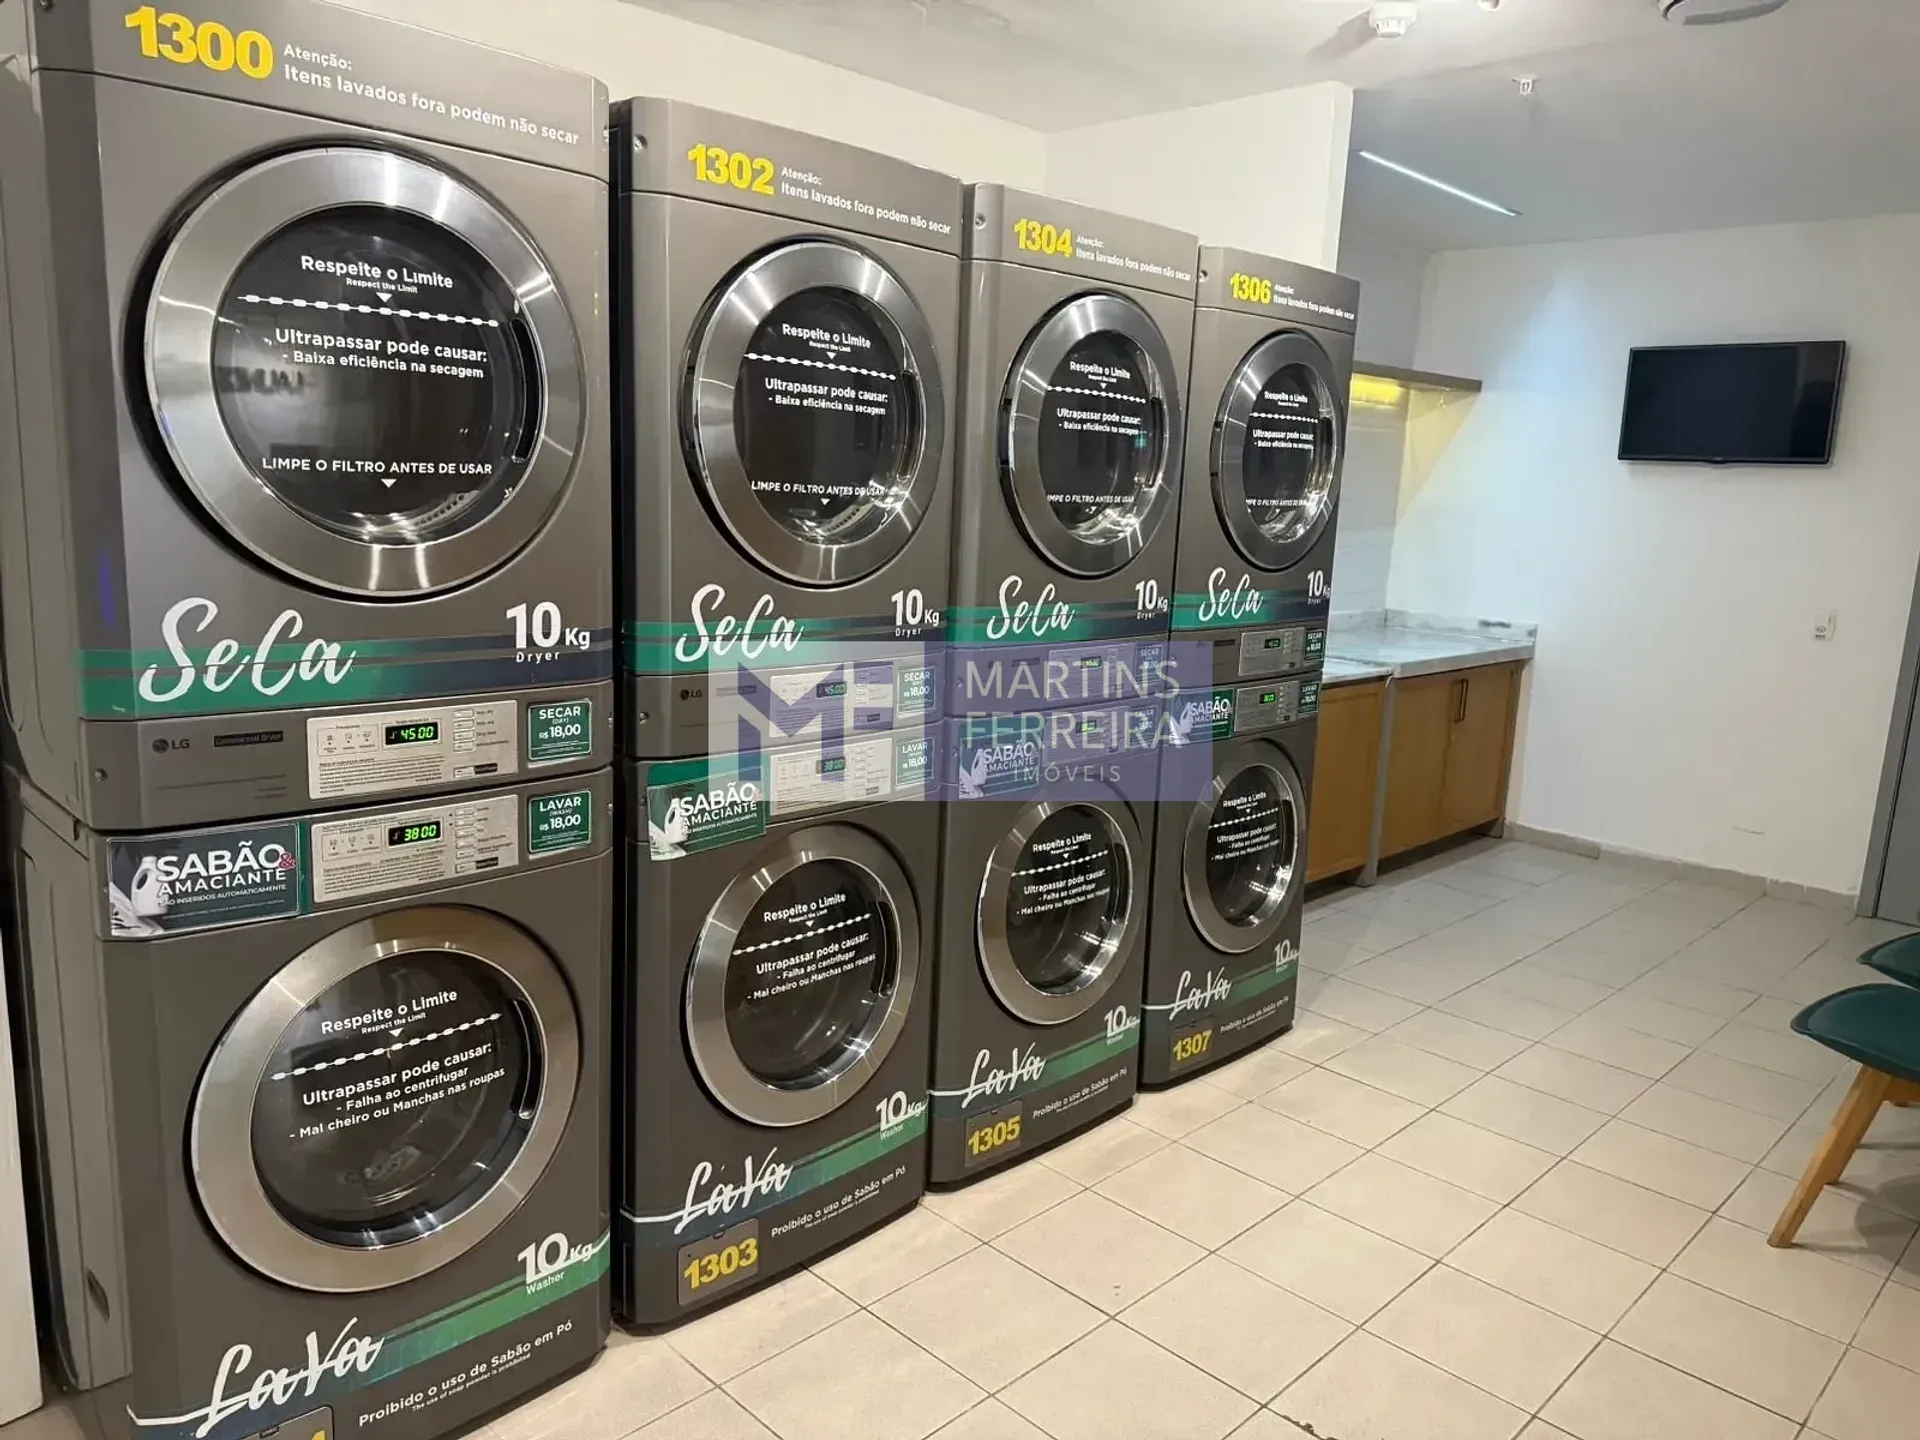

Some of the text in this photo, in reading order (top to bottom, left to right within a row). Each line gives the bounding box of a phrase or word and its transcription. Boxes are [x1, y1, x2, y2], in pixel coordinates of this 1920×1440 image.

[125, 6, 274, 80] 1300
[284, 43, 352, 70] Atenção:
[284, 63, 579, 145] Itens lavados fora podem não secar
[687, 143, 775, 196] 1302
[781, 167, 822, 186] Atenção:
[781, 182, 951, 234] Itens lavados fora podem não secar
[1013, 217, 1073, 258] 1304
[300, 255, 454, 288] Respeite o Limite
[346, 277, 418, 293] Respect the Limit
[1230, 272, 1272, 304] 1306
[275, 328, 488, 363] Ultrapassar pode causar:
[782, 323, 831, 343] Respeite
[833, 333, 840, 344] o
[842, 332, 871, 349] Limite
[293, 350, 484, 379] Baixa eficiência na secagem
[765, 377, 888, 403] Ultrapassar pode causar:
[775, 394, 886, 416] Baixa eficiência na secagem
[1057, 408, 1101, 420] Ultrapassar
[262, 457, 493, 475] LIMPE O FILTRO ANTES DE USAR
[751, 480, 853, 497] LIMPE O FILTRO ANTES
[986, 574, 1075, 640] SeCa
[1198, 566, 1263, 622] SeCa
[675, 583, 804, 663] SeCa
[895, 627, 922, 637] Dryer
[138, 596, 357, 702] SeCa
[516, 649, 560, 664] Dryer
[539, 706, 581, 720] SECAR
[1191, 696, 1229, 714] SABÃO
[172, 738, 190, 750] LG
[983, 738, 1035, 765] SABÃO
[539, 796, 582, 812] LAVAR
[680, 781, 757, 817] SABÃO
[681, 800, 758, 827] AMACIANTE
[156, 840, 285, 882] SABÃO
[158, 867, 287, 897] AMACIANTE
[176, 892, 216, 905] INSERIDOS
[217, 883, 287, 899] AUTOMATICAMENTE
[764, 903, 808, 923] Respeite
[810, 901, 817, 910] o
[818, 892, 847, 909] Limite
[756, 932, 869, 975] Ultrapassar pode causar:
[783, 949, 856, 980] Falha ao centrifugar
[753, 960, 855, 1000] Mal cheiro ou Manchas nas
[321, 989, 458, 1035] Respeite o Limite
[361, 1011, 427, 1035] Respect the Limit
[1173, 1029, 1212, 1061] 1307
[302, 1042, 492, 1106] Ultrapassar pode causar:
[346, 1066, 469, 1112] Falha ao centrifugar
[299, 1066, 506, 1139] Mal cheiro ou Manchas nas roupas
[968, 1115, 1021, 1156] 1305
[771, 1211, 813, 1238] Proibido
[814, 1209, 822, 1219] o
[823, 1200, 840, 1216] uso
[841, 1190, 853, 1205] de
[854, 1177, 880, 1201] Sabão
[683, 1236, 759, 1290] 1303
[526, 1271, 565, 1295] Washer
[359, 1319, 573, 1427] Proibido o uso de Sabão em Pó
